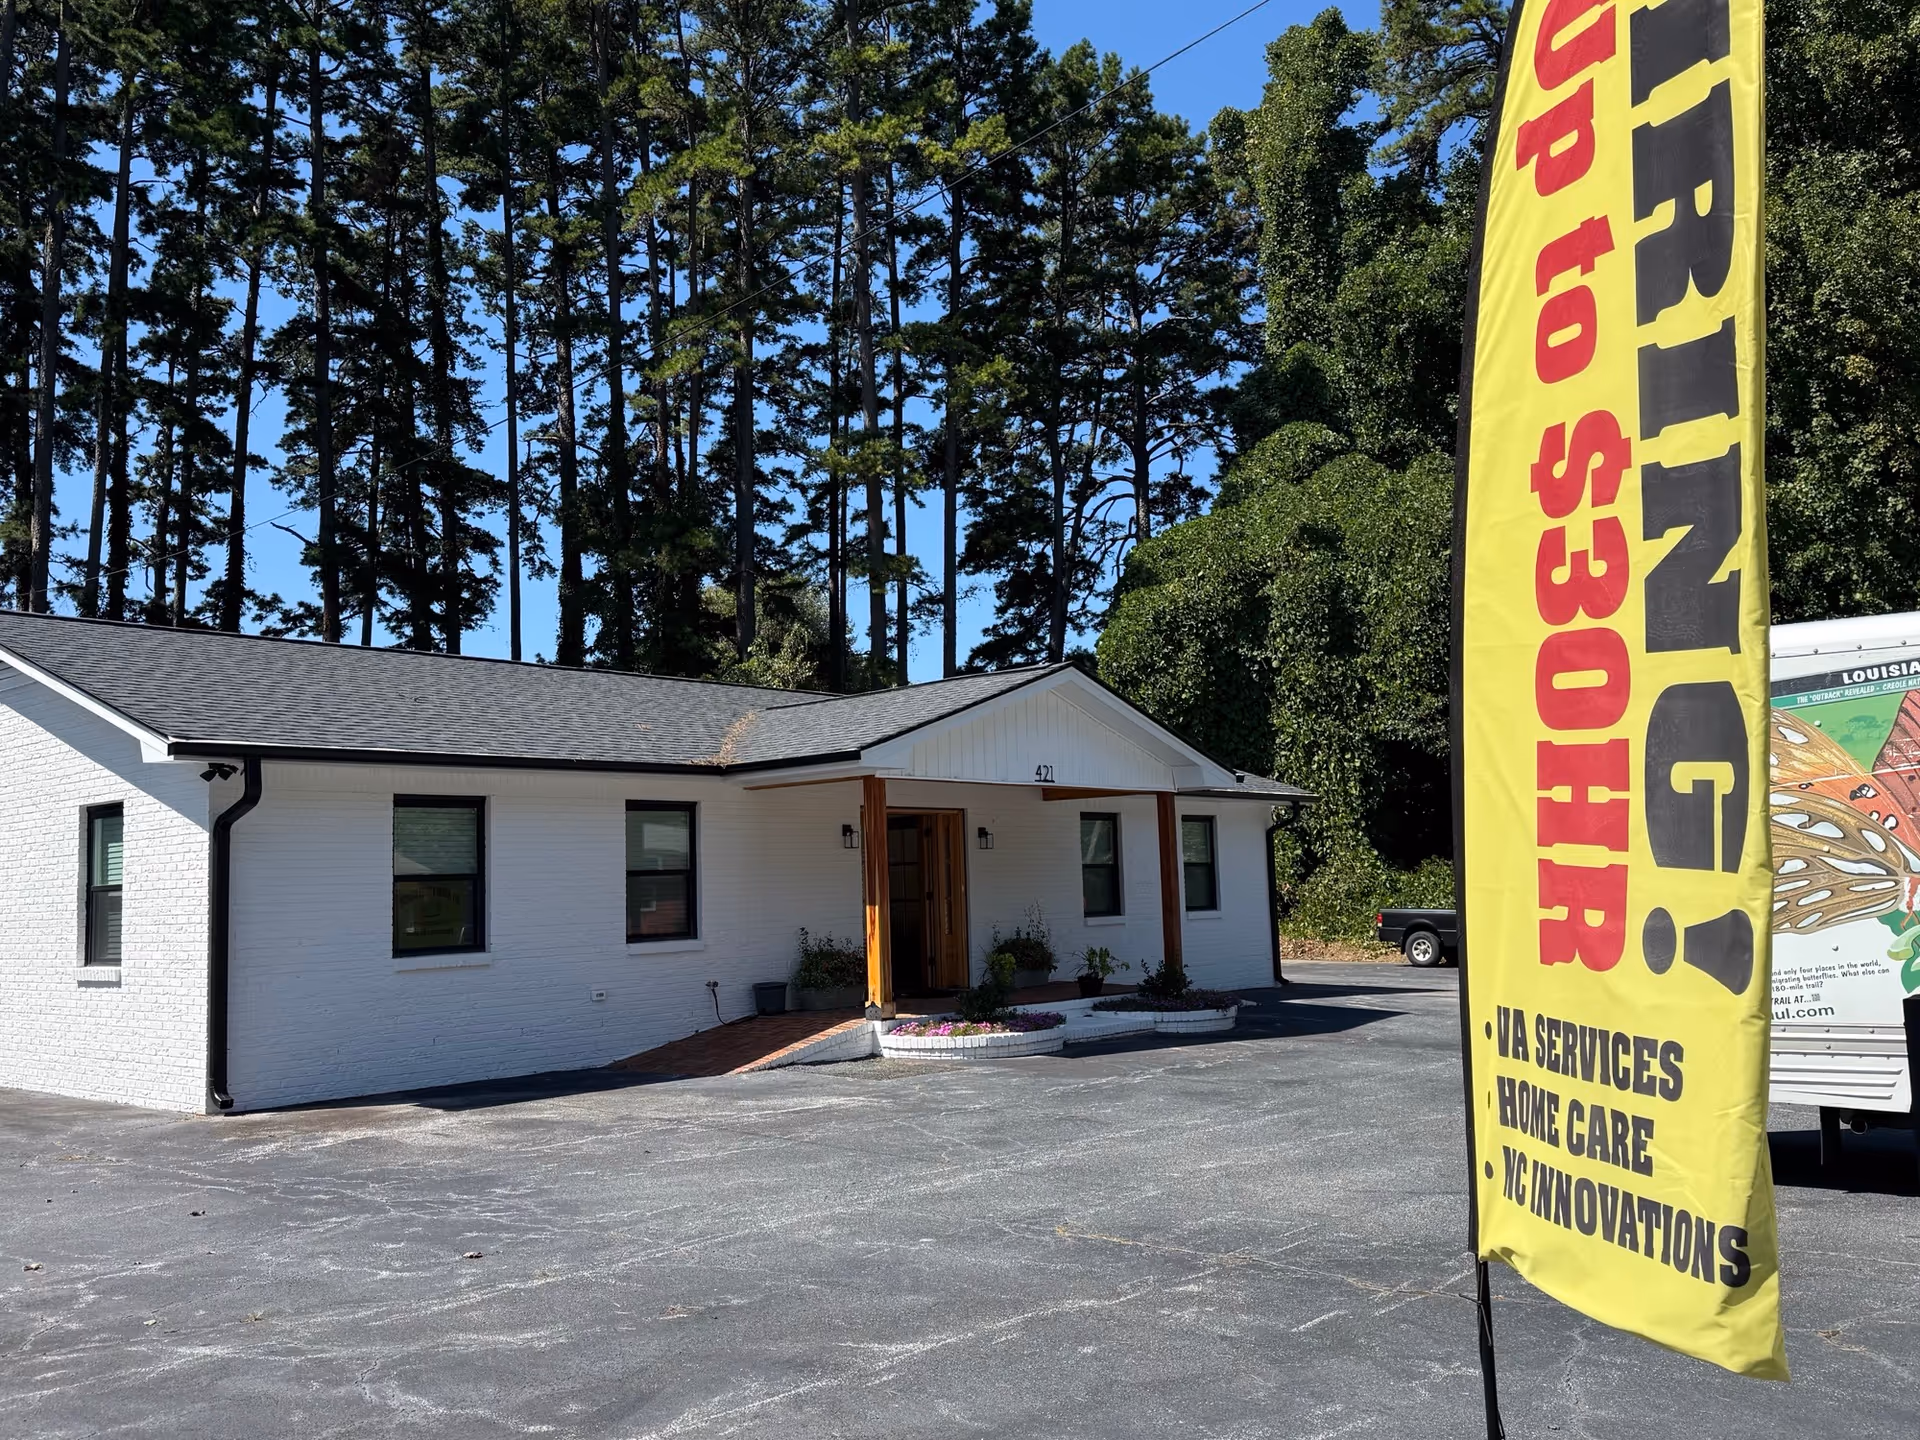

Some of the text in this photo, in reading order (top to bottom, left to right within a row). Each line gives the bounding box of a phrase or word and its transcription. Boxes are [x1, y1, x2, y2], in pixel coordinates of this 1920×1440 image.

[1535, 214, 1616, 384] to
[1797, 696, 1808, 704] THE
[1845, 685, 1875, 696] REVEALED
[1882, 680, 1906, 691] CREOLE
[1034, 764, 1056, 783] 421
[1784, 967, 1797, 976] only
[1799, 966, 1813, 974] four
[1815, 964, 1836, 973] places
[1847, 961, 1858, 969] the
[1860, 959, 1881, 968] world,
[1802, 972, 1839, 981] butterflies.
[1841, 970, 1860, 978] What
[1806, 980, 1824, 990] trail?
[1497, 1004, 1685, 1102] VA SERVICES
[1496, 1075, 1655, 1177] HOME CARE
[1529, 1159, 1751, 1288] INNOVATIONS
